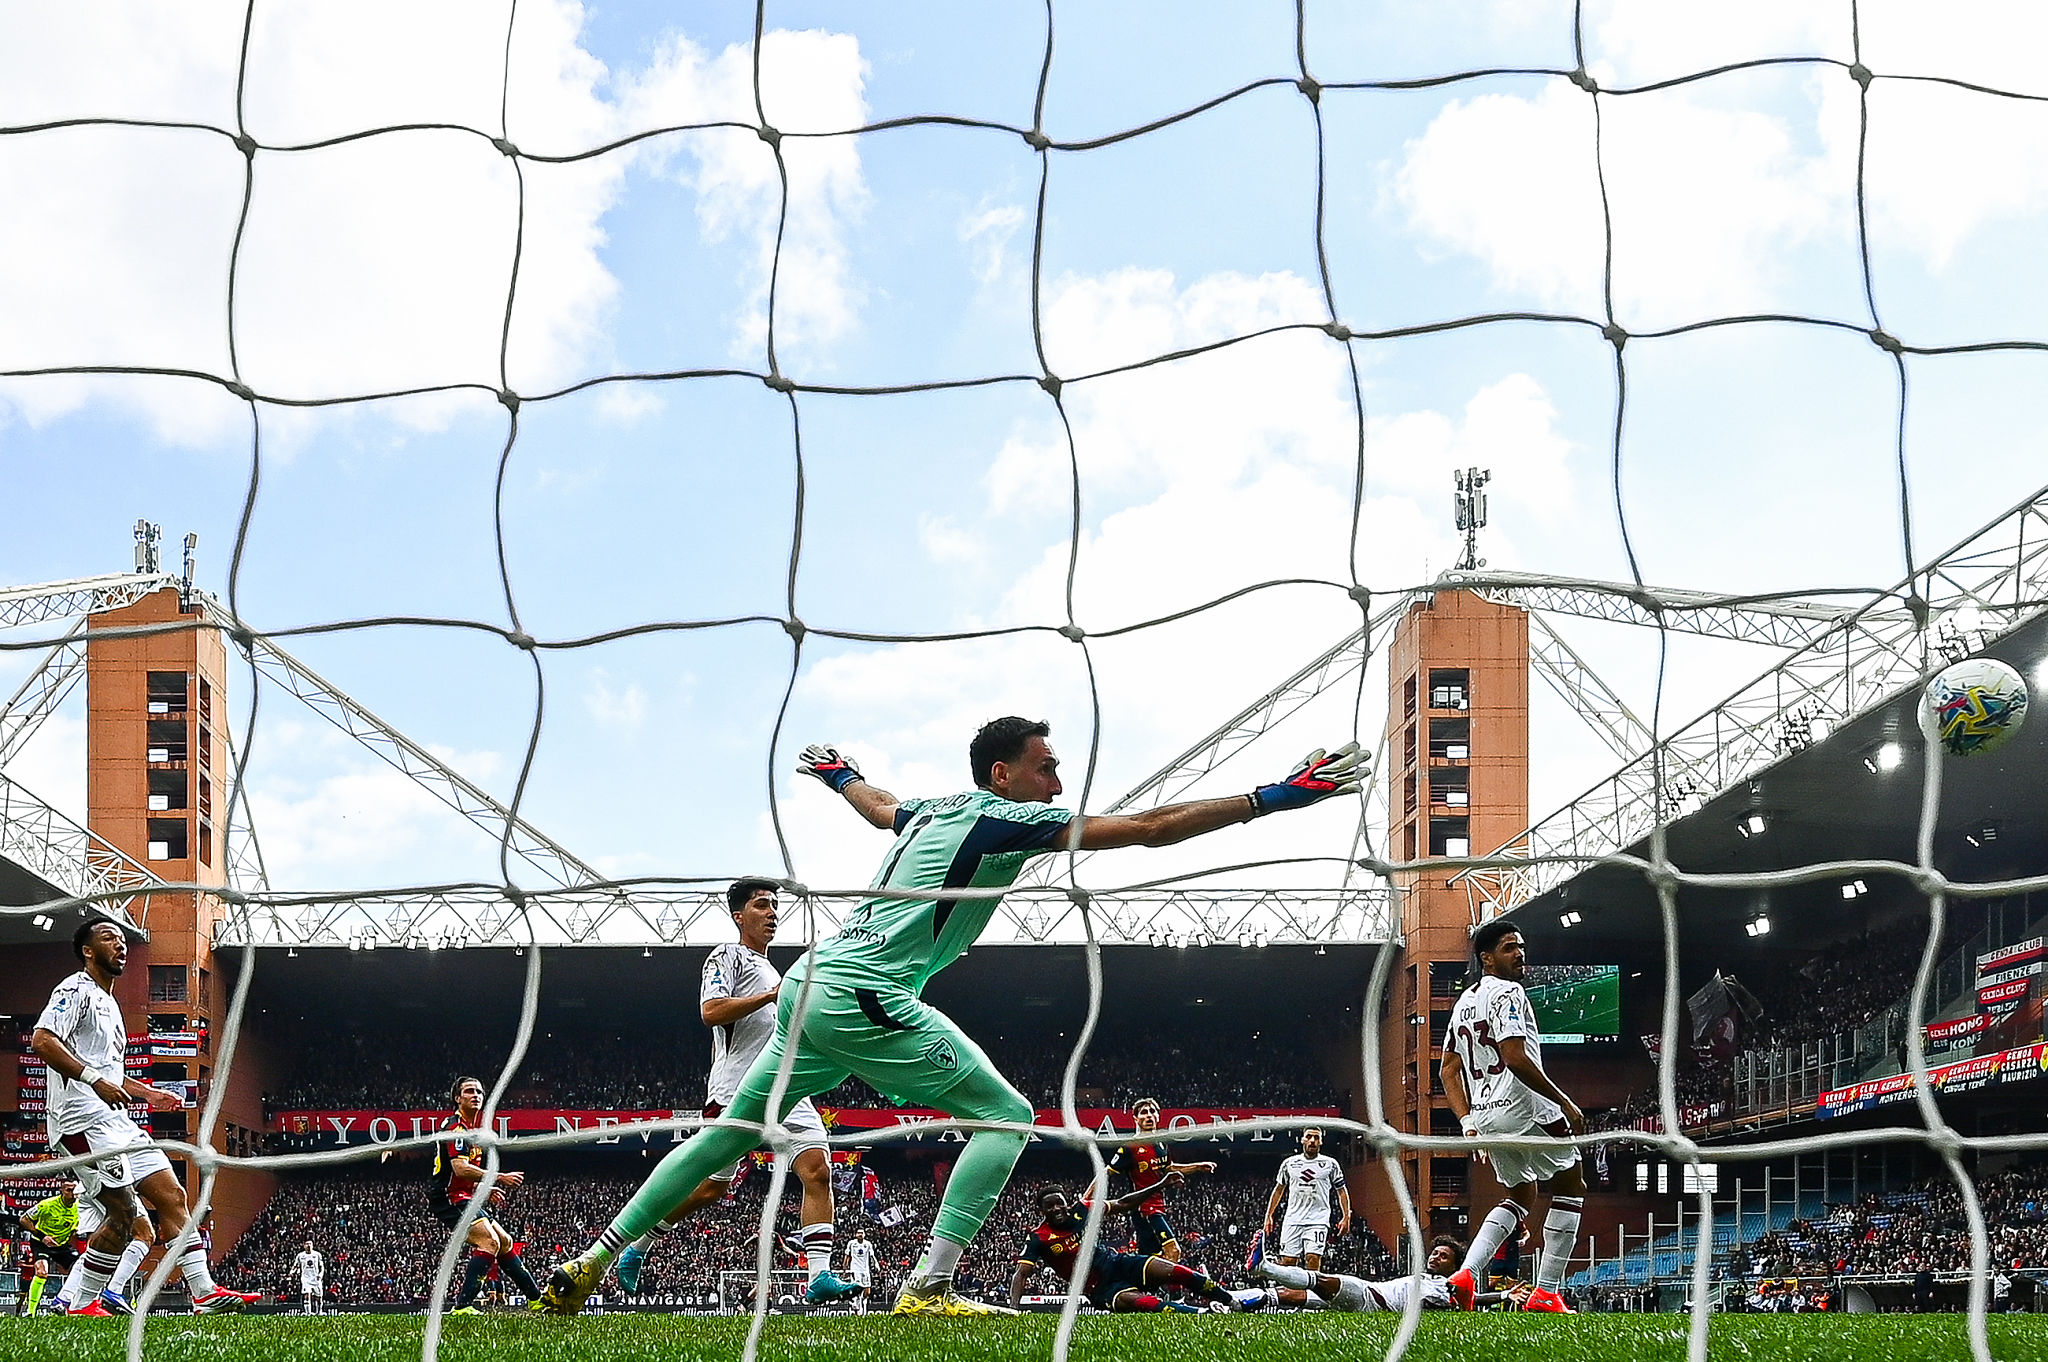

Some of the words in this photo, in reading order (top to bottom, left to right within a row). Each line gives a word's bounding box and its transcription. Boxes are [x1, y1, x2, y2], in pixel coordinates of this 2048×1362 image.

[1949, 1015, 1984, 1036] HONG
[1457, 1019, 1507, 1081] 23
[1878, 1088, 1921, 1105] MONTEROSS
[1094, 1114, 1275, 1142] AONE
[1314, 1231, 1325, 1243] 10
[627, 1296, 703, 1306] NAVIGARE
